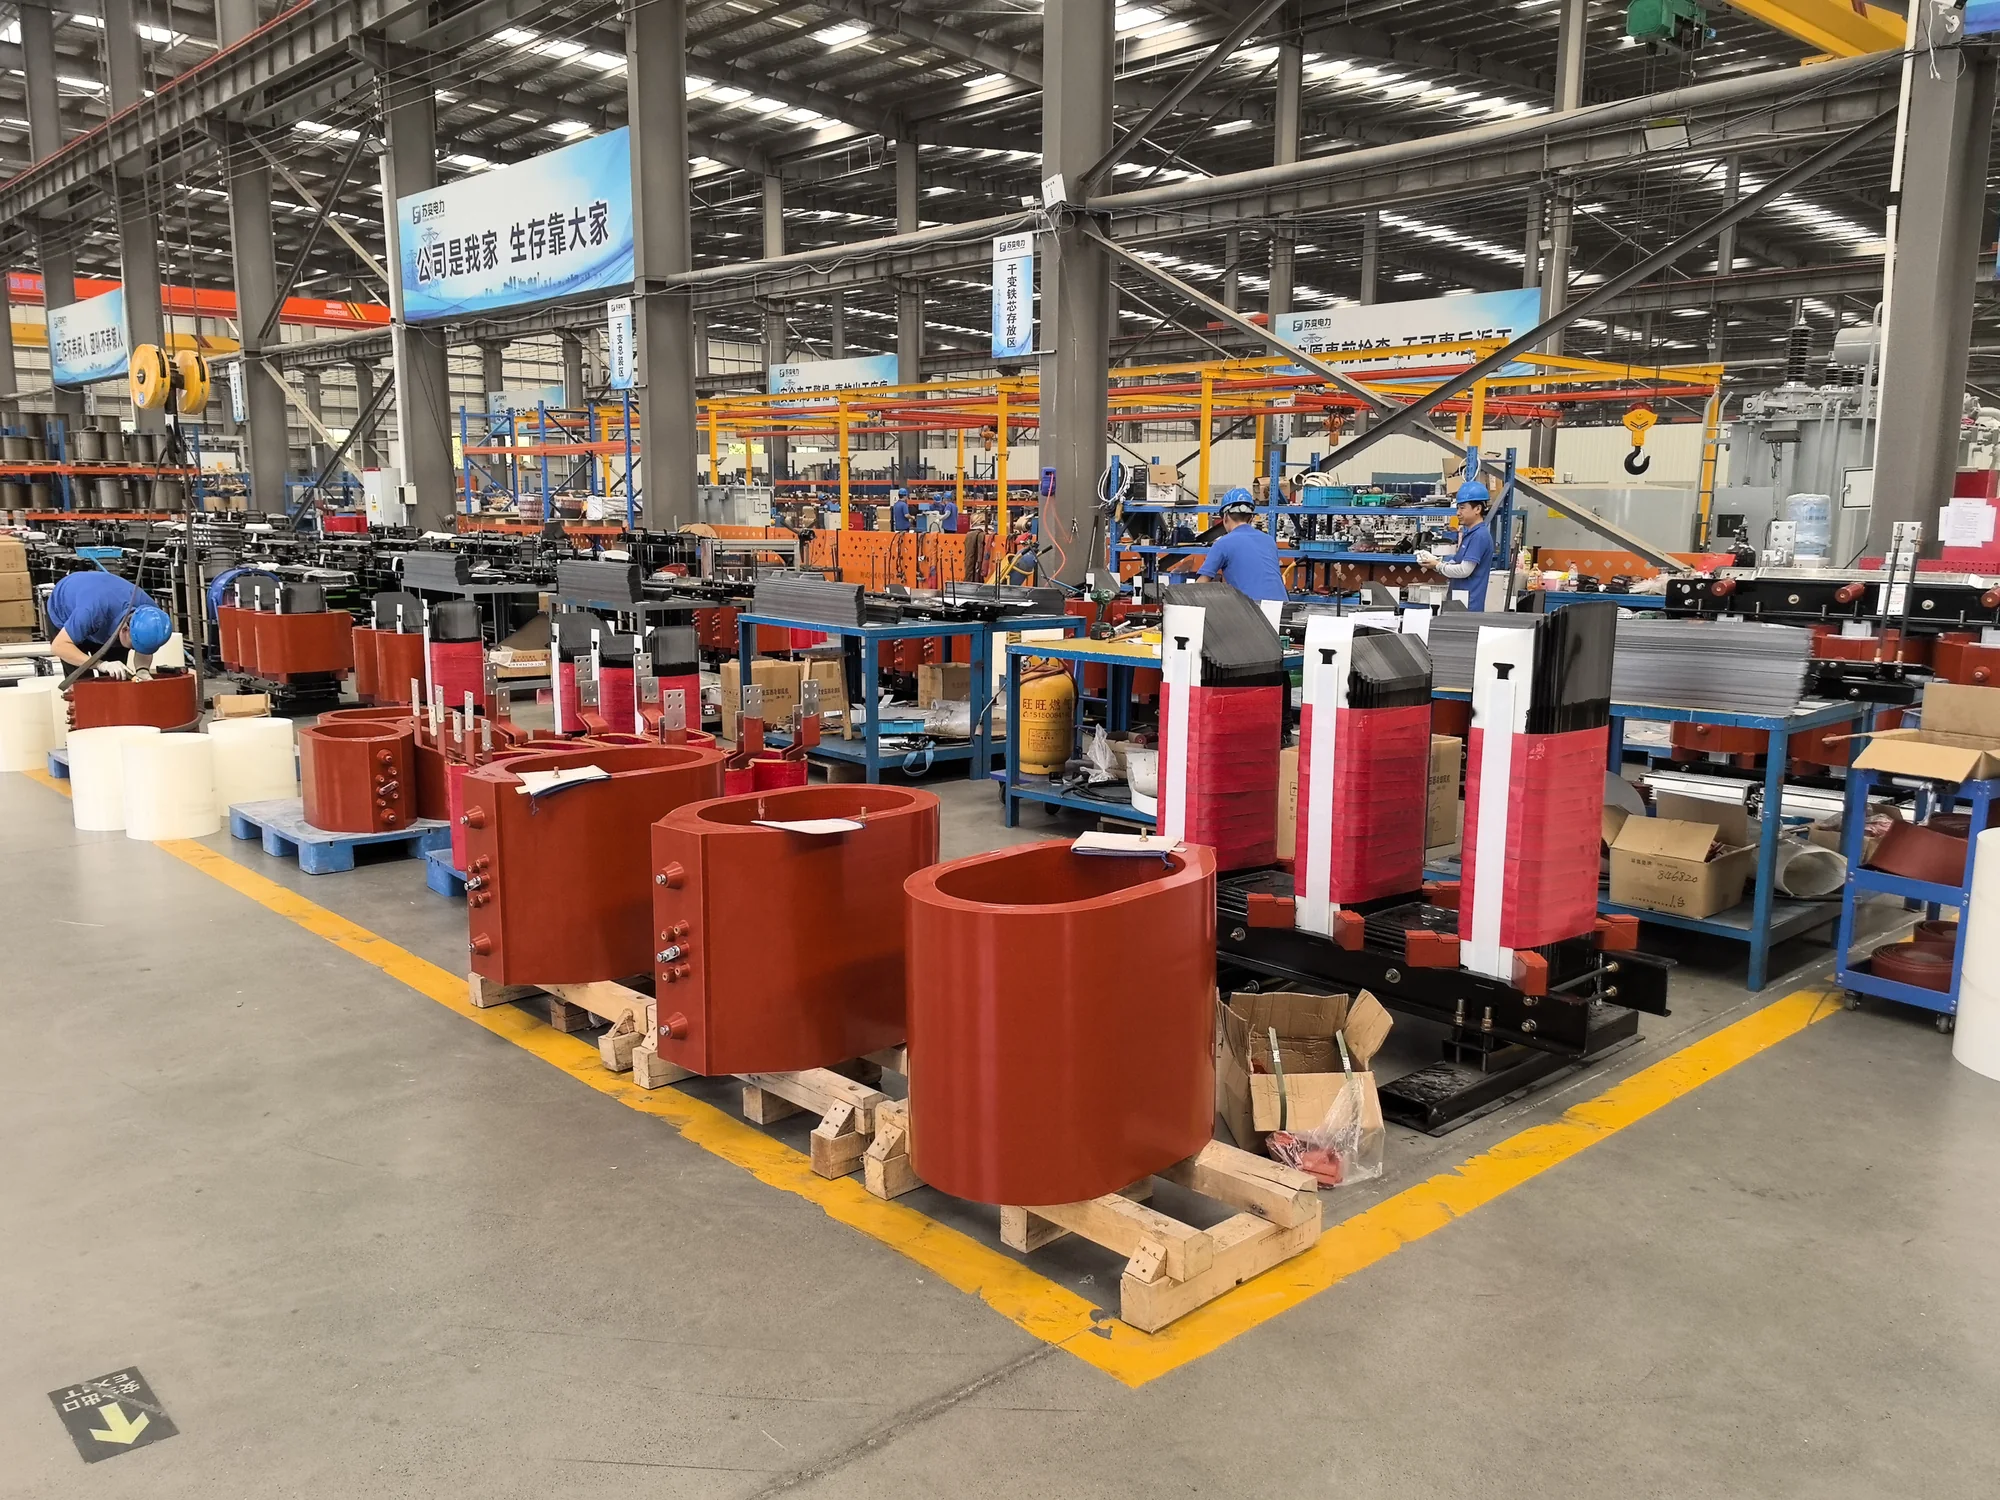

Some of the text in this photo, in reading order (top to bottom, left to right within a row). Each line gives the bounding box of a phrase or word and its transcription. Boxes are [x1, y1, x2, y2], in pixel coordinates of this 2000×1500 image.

[421, 199, 445, 217] 苏变电力
[417, 201, 609, 282] 公司是我家 生存靠大家
[1006, 263, 1018, 348] 干变铁芯存放区
[1304, 318, 1332, 328] 苏变电力
[1022, 698, 1072, 711] 旺旺燃气
[1657, 870, 1698, 883] 846820
